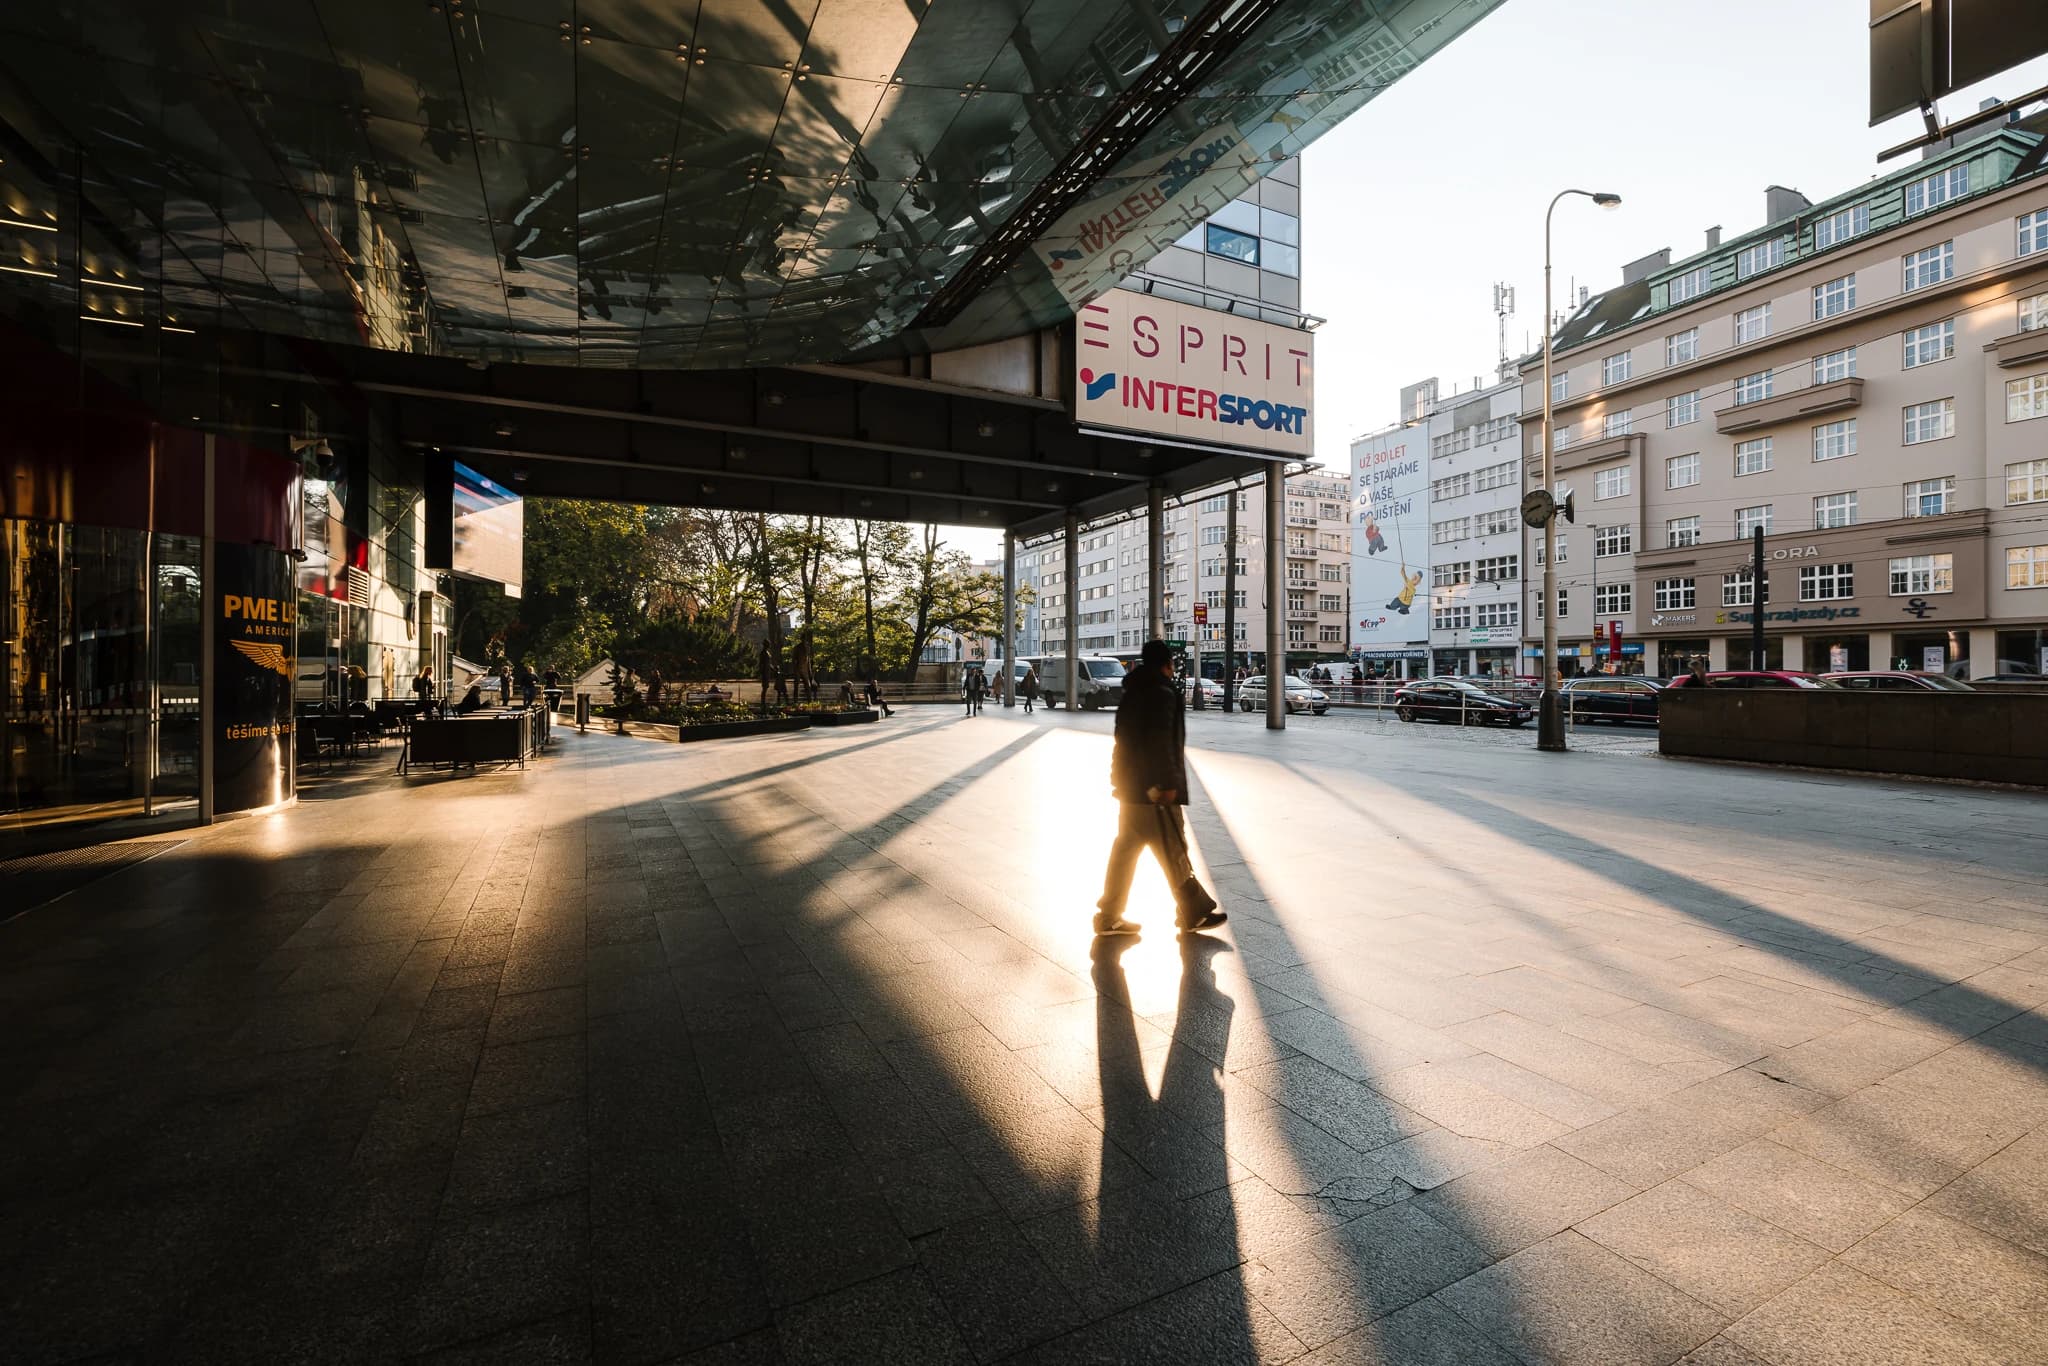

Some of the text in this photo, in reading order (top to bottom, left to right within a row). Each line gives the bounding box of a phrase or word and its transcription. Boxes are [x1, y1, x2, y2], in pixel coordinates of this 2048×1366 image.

[1083, 304, 1308, 387] ESPRIT
[1122, 375, 1307, 435] INTERSPORT
[1360, 444, 1407, 469] UŽ 30 LET
[1360, 460, 1419, 487] SE STARÁME
[1360, 485, 1393, 505] O VAŠE
[224, 594, 278, 622] PME
[1665, 614, 1696, 622] MAKERS
[226, 722, 268, 739] těšíme
[271, 724, 280, 736] se
